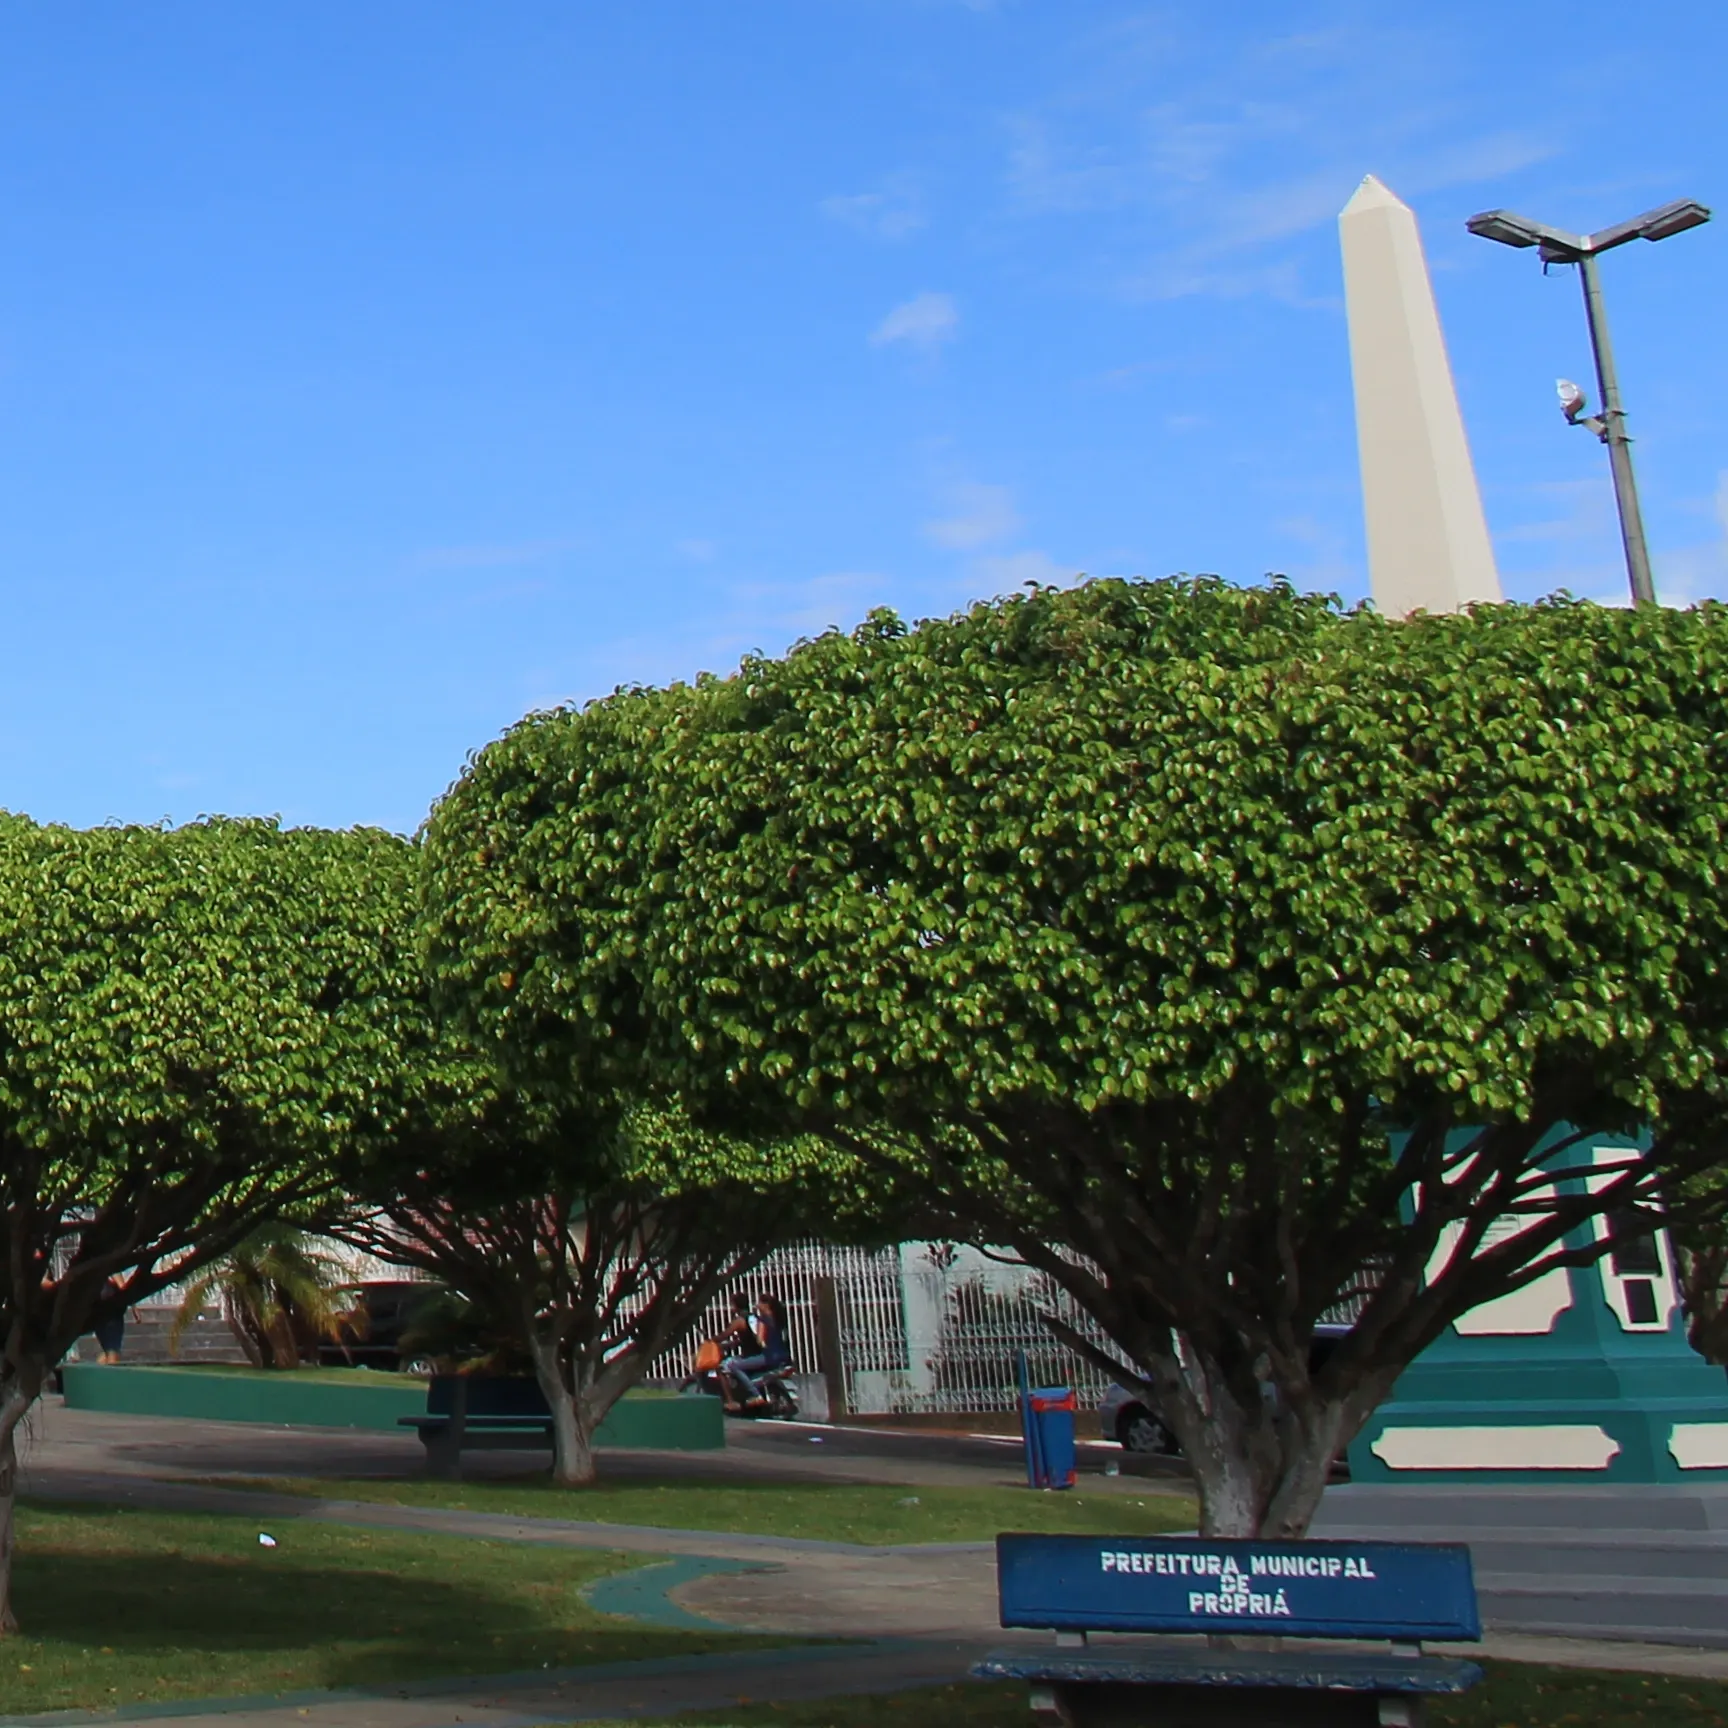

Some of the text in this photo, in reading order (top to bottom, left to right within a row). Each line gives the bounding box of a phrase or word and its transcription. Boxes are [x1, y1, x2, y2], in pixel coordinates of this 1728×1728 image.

[1100, 1551, 1376, 1578] PREFEITURA MUNICIPAL
[1220, 1573, 1250, 1594] DE
[1188, 1588, 1291, 1615] PROPRIÁ
